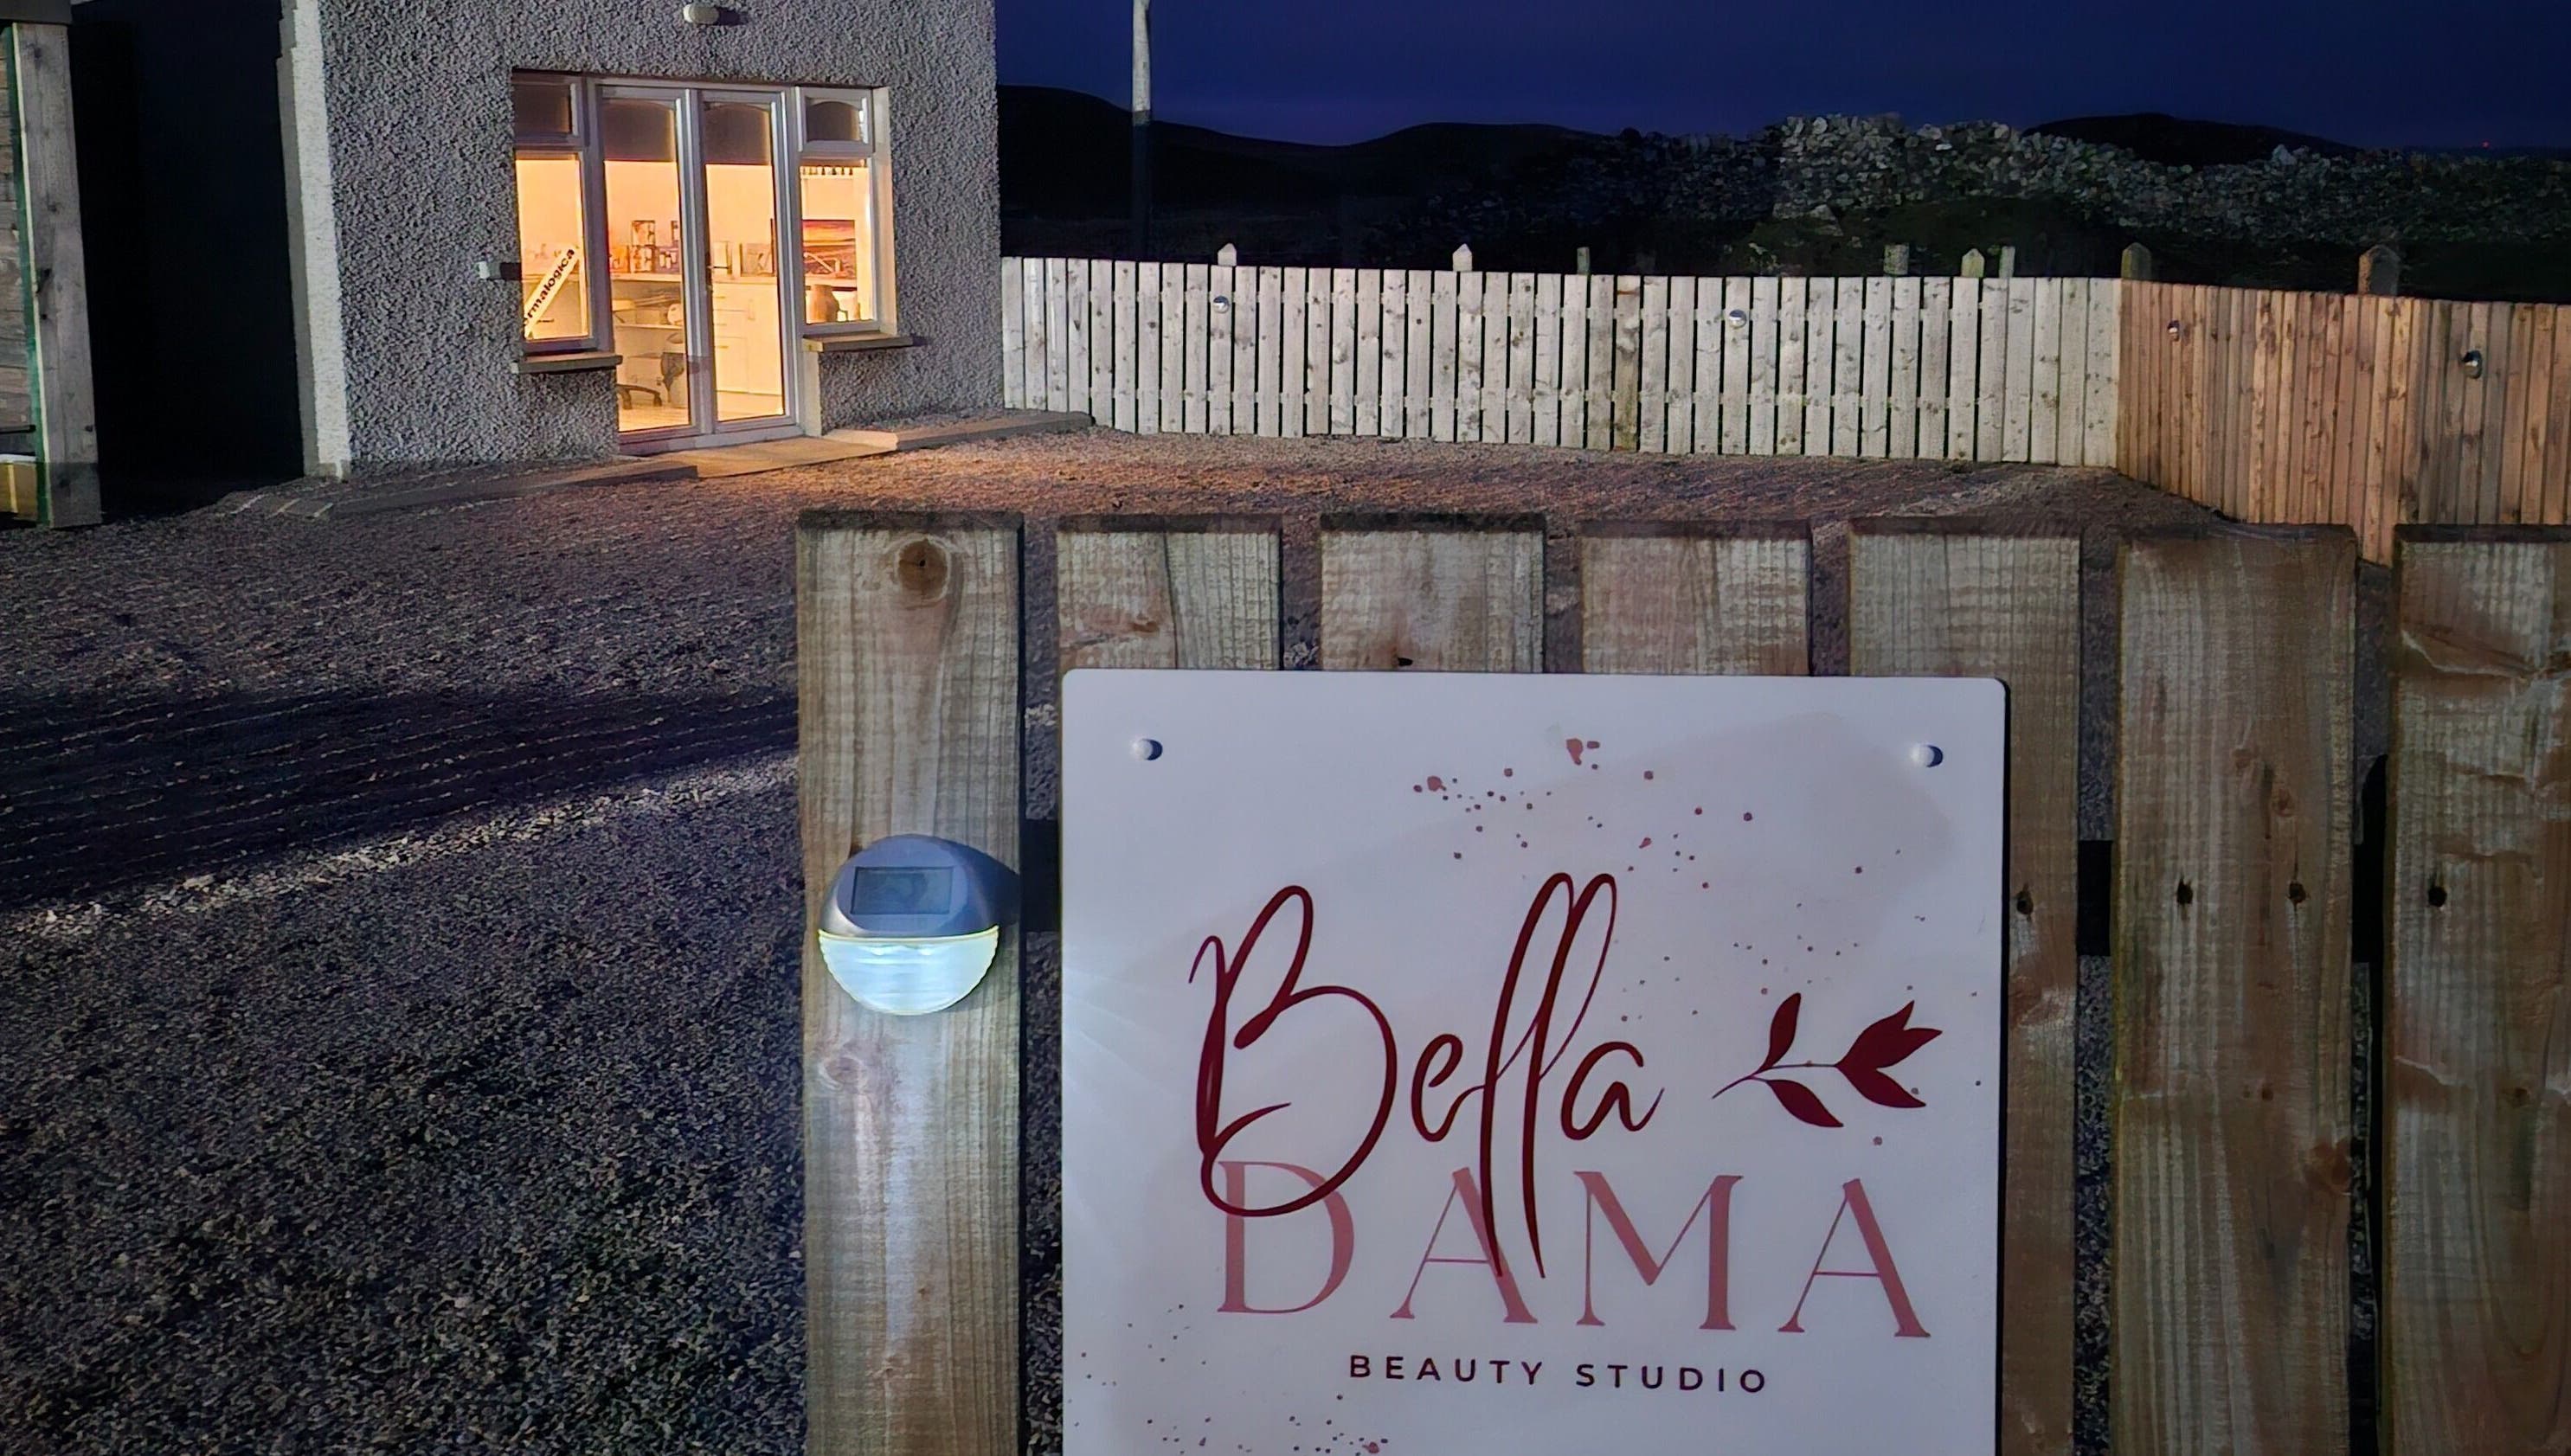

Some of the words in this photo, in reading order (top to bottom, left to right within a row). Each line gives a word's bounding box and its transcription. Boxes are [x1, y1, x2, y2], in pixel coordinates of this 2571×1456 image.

[1189, 873, 1664, 1278] Bella
[1217, 1160, 1931, 1338] DAMA
[1349, 1354, 1546, 1386] BEAUTY
[1576, 1363, 1766, 1394] STUDIO
